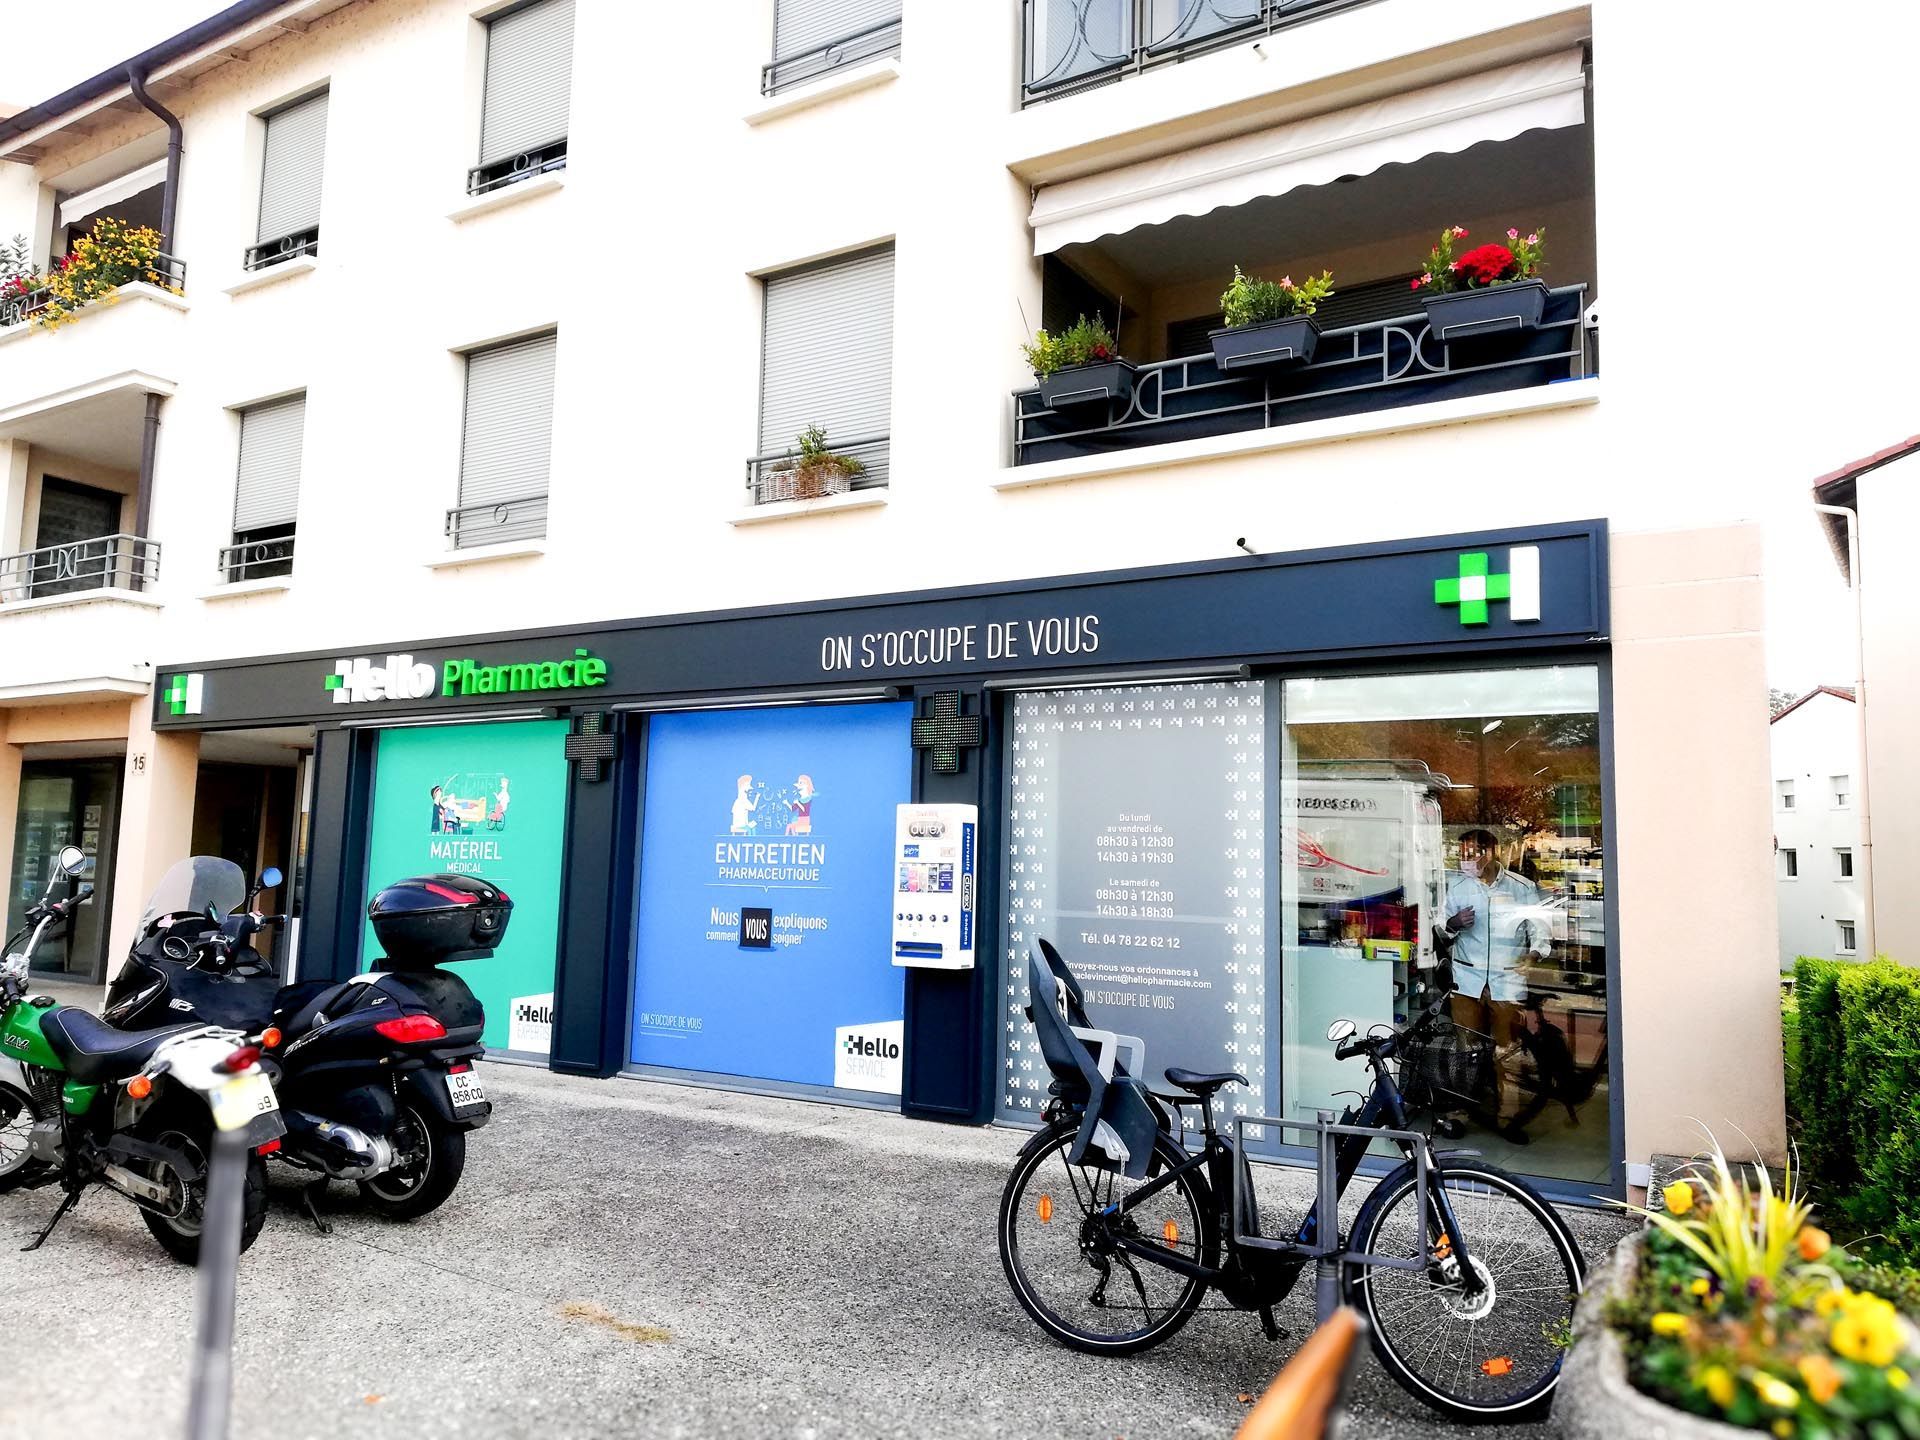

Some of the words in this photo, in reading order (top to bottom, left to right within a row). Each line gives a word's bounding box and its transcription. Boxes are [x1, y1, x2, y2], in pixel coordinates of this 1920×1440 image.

[821, 636, 852, 671] ON
[860, 625, 977, 669] S'OCCUPE
[987, 621, 1019, 659] DE
[1027, 615, 1099, 656] VOUS
[325, 654, 435, 703] Hello
[442, 649, 607, 696] Pharmacie
[133, 755, 146, 771] 15
[1119, 813, 1129, 822] Du
[1131, 813, 1151, 822] lundi
[1107, 825, 1117, 833] au
[1118, 824, 1152, 833] vendredi
[1154, 825, 1163, 833] de
[430, 837, 502, 860] MATÉRIEL
[1096, 836, 1129, 847] 08h30
[1131, 836, 1138, 847] à
[1141, 837, 1174, 848] 12h30
[715, 843, 825, 865] ENTRETIEN
[1097, 852, 1129, 863] 14h30
[1131, 852, 1138, 863] à
[1141, 852, 1174, 863] 19h30
[446, 861, 483, 873] MÉDICAL
[718, 866, 820, 881] PHARMACEUTIQUE
[1109, 878, 1119, 886] Le
[1120, 878, 1149, 887] samedi
[1150, 879, 1160, 887] de
[1096, 889, 1128, 900] 08h30
[1131, 889, 1137, 901] à
[1141, 891, 1174, 902] 12h30
[1096, 905, 1128, 917] 14h30
[1131, 905, 1137, 917] à
[1141, 907, 1174, 918] 18h30
[710, 907, 739, 926] Nous
[745, 918, 768, 940] VOUS
[773, 913, 828, 932] expliquons
[706, 930, 739, 942] comment
[1081, 932, 1101, 944] Tél.
[1103, 934, 1116, 945] 04
[1119, 935, 1132, 945] 78
[1135, 936, 1147, 946] 22
[1150, 937, 1164, 948] 62
[1167, 938, 1181, 949] 12
[1136, 965, 1192, 977] ordonnances
[1193, 968, 1199, 977] à
[1084, 989, 1096, 1003] ON
[1097, 990, 1137, 1007] S'OCCUPE
[1139, 993, 1150, 1008] DE
[1152, 994, 1175, 1010] VOUS
[687, 1017, 703, 1030] VOUS
[843, 1034, 899, 1059] Hello
[845, 1057, 886, 1079] SERVICE
